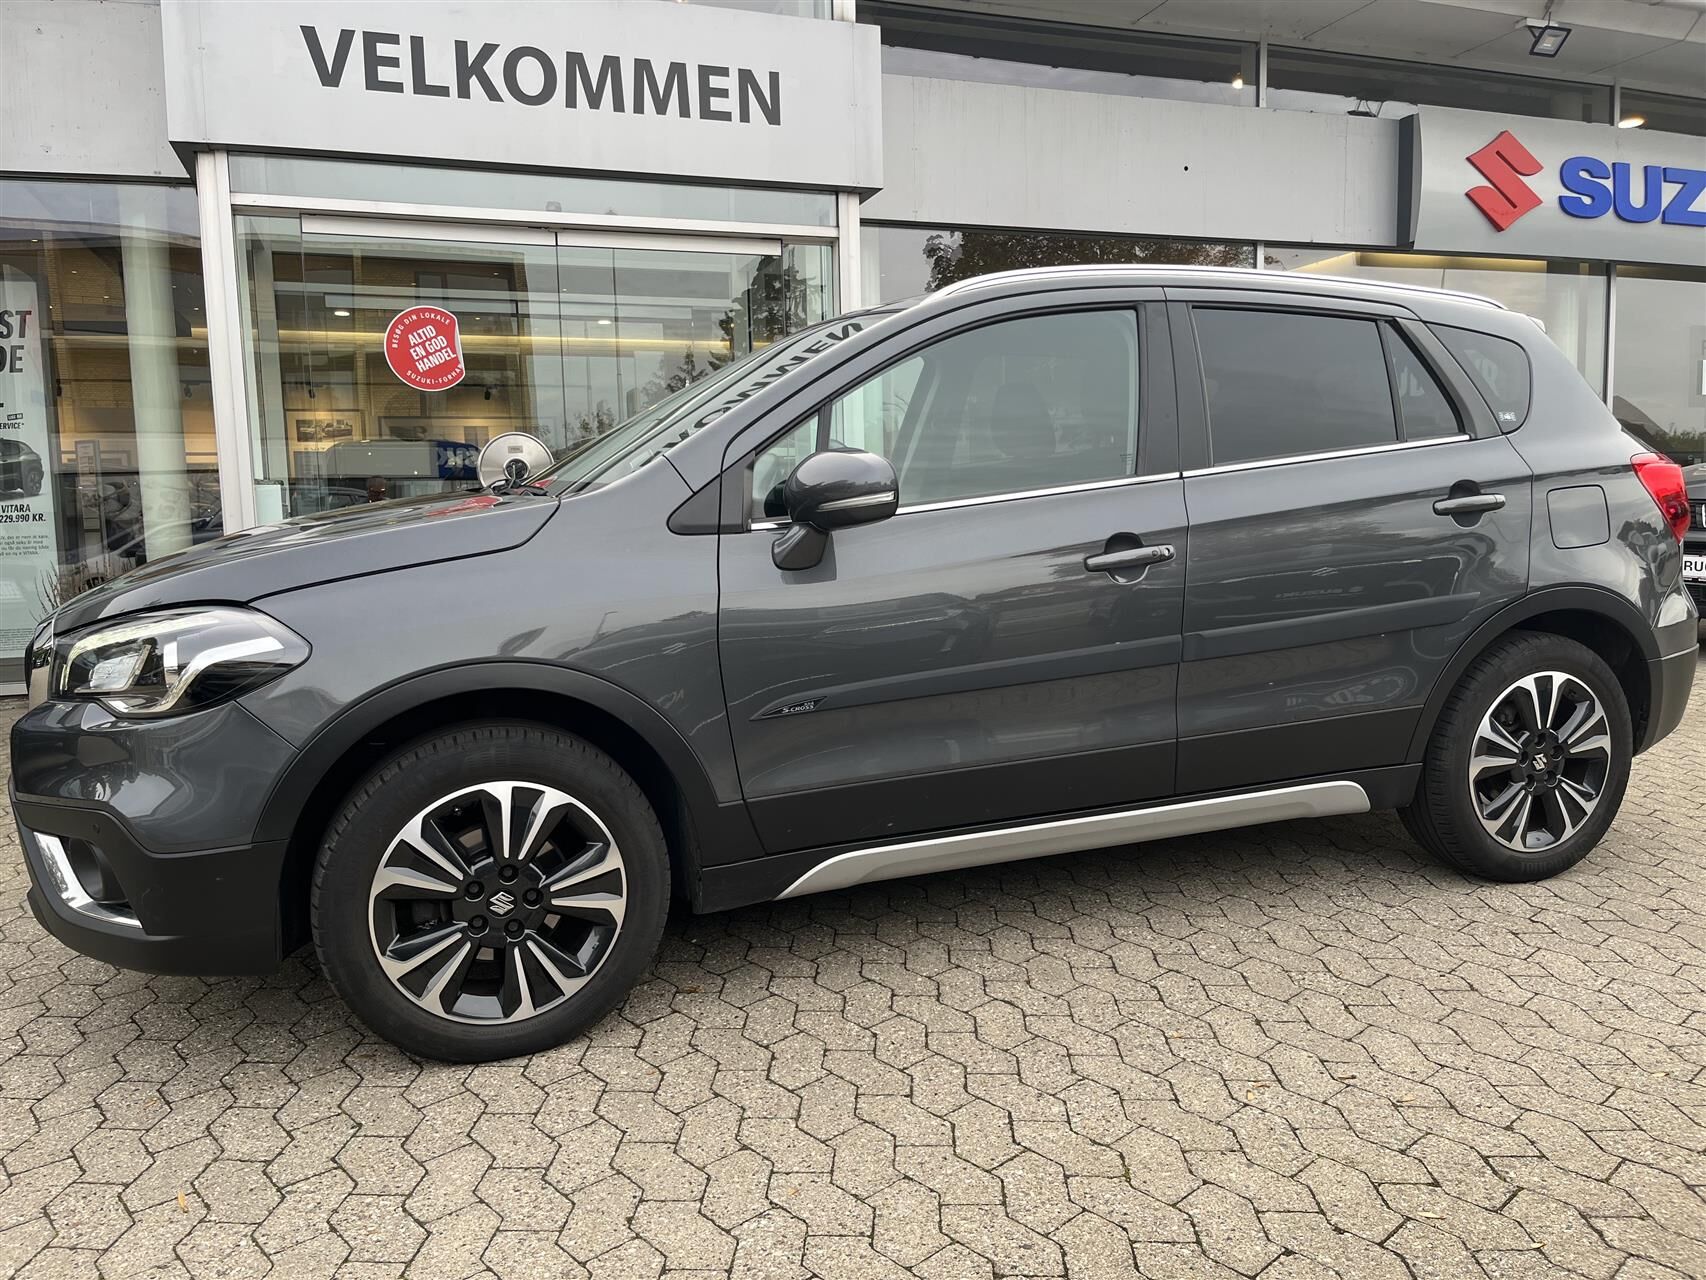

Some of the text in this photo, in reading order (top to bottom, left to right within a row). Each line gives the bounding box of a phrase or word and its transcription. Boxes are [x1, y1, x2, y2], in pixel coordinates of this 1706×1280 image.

[299, 25, 781, 126] VELKOMMEN
[1559, 156, 1706, 227] SUZ
[391, 312, 451, 348] BESØG DIN LOKALE
[408, 325, 437, 347] ALTID
[410, 335, 448, 360] EN GOD
[415, 347, 457, 373] HANDEL
[1, 504, 31, 513] VITARA
[32, 513, 46, 522] KR.
[1684, 560, 1706, 572] RU
